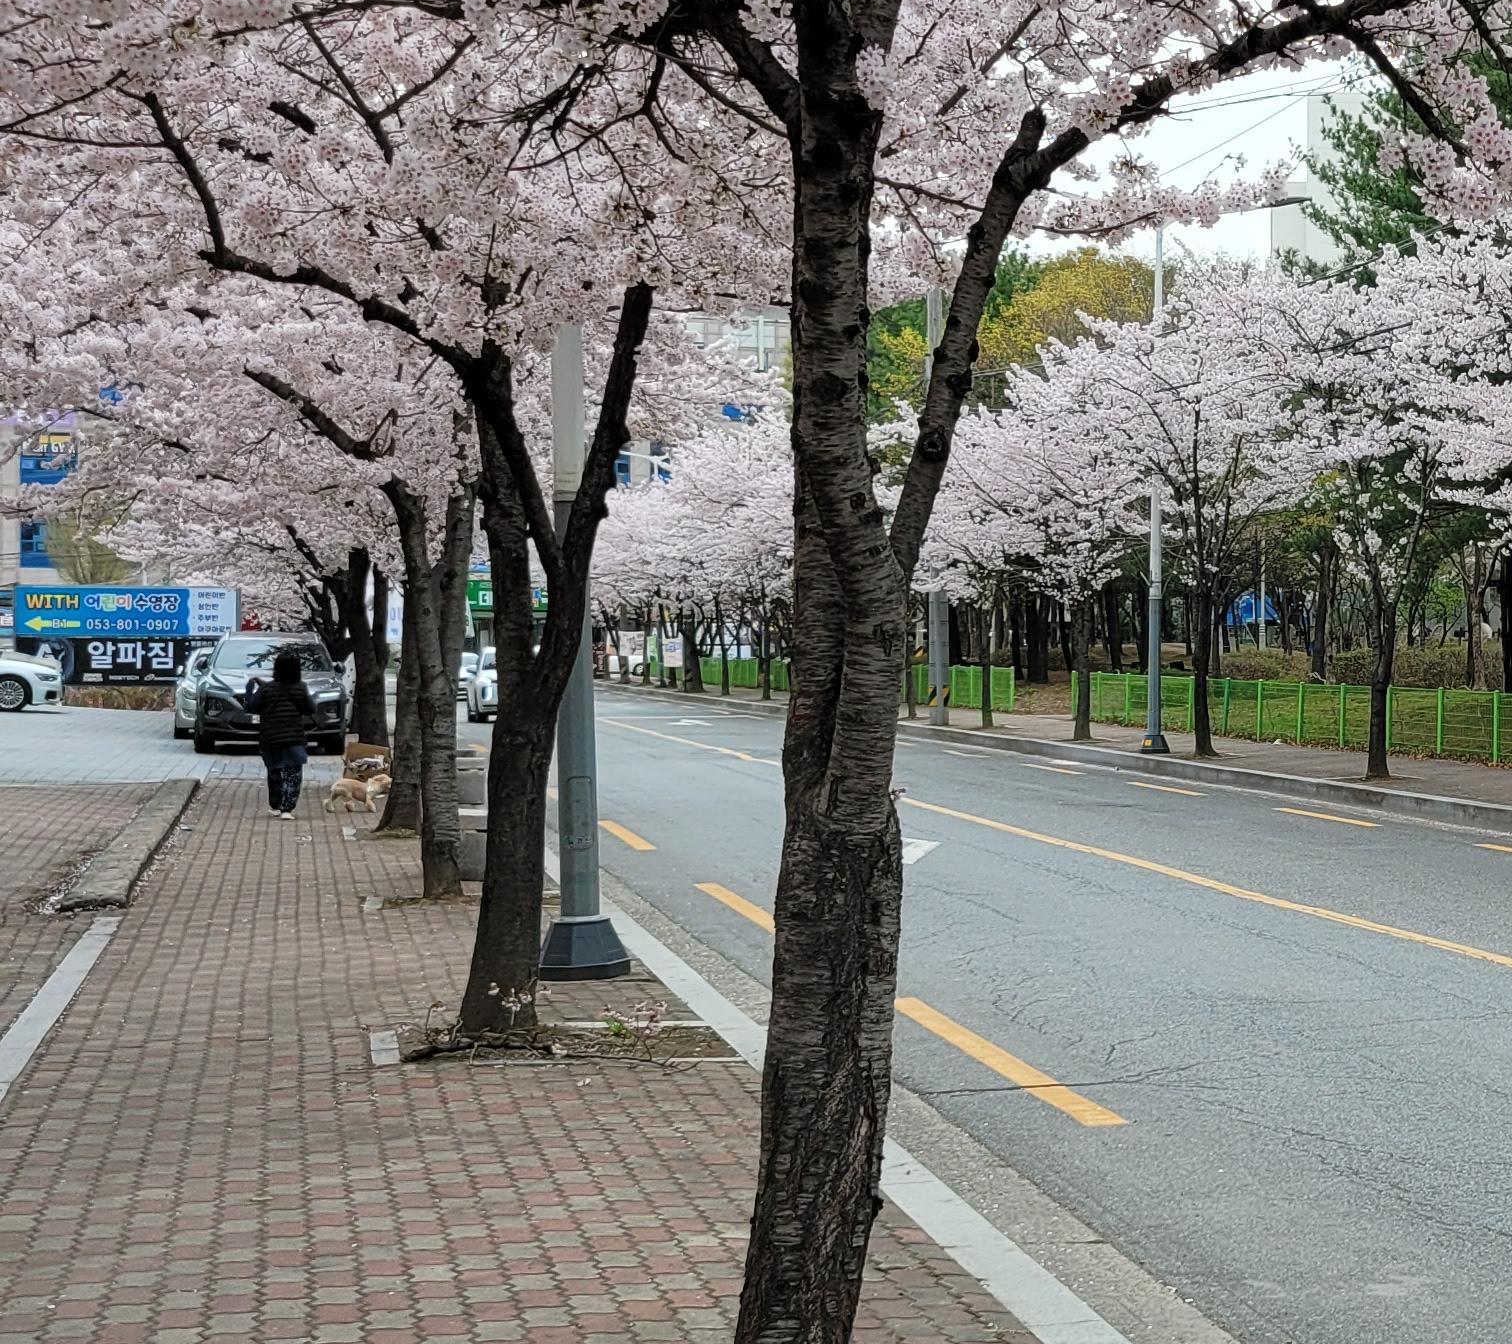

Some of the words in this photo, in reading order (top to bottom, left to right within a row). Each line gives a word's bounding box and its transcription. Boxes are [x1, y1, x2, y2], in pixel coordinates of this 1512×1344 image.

[25, 593, 79, 610] WITH
[84, 593, 132, 612] 어린이
[134, 593, 181, 613] 수영장
[198, 591, 226, 600] 어린이반
[86, 618, 179, 631] 053-801-0907
[87, 641, 174, 670] 알파짐
